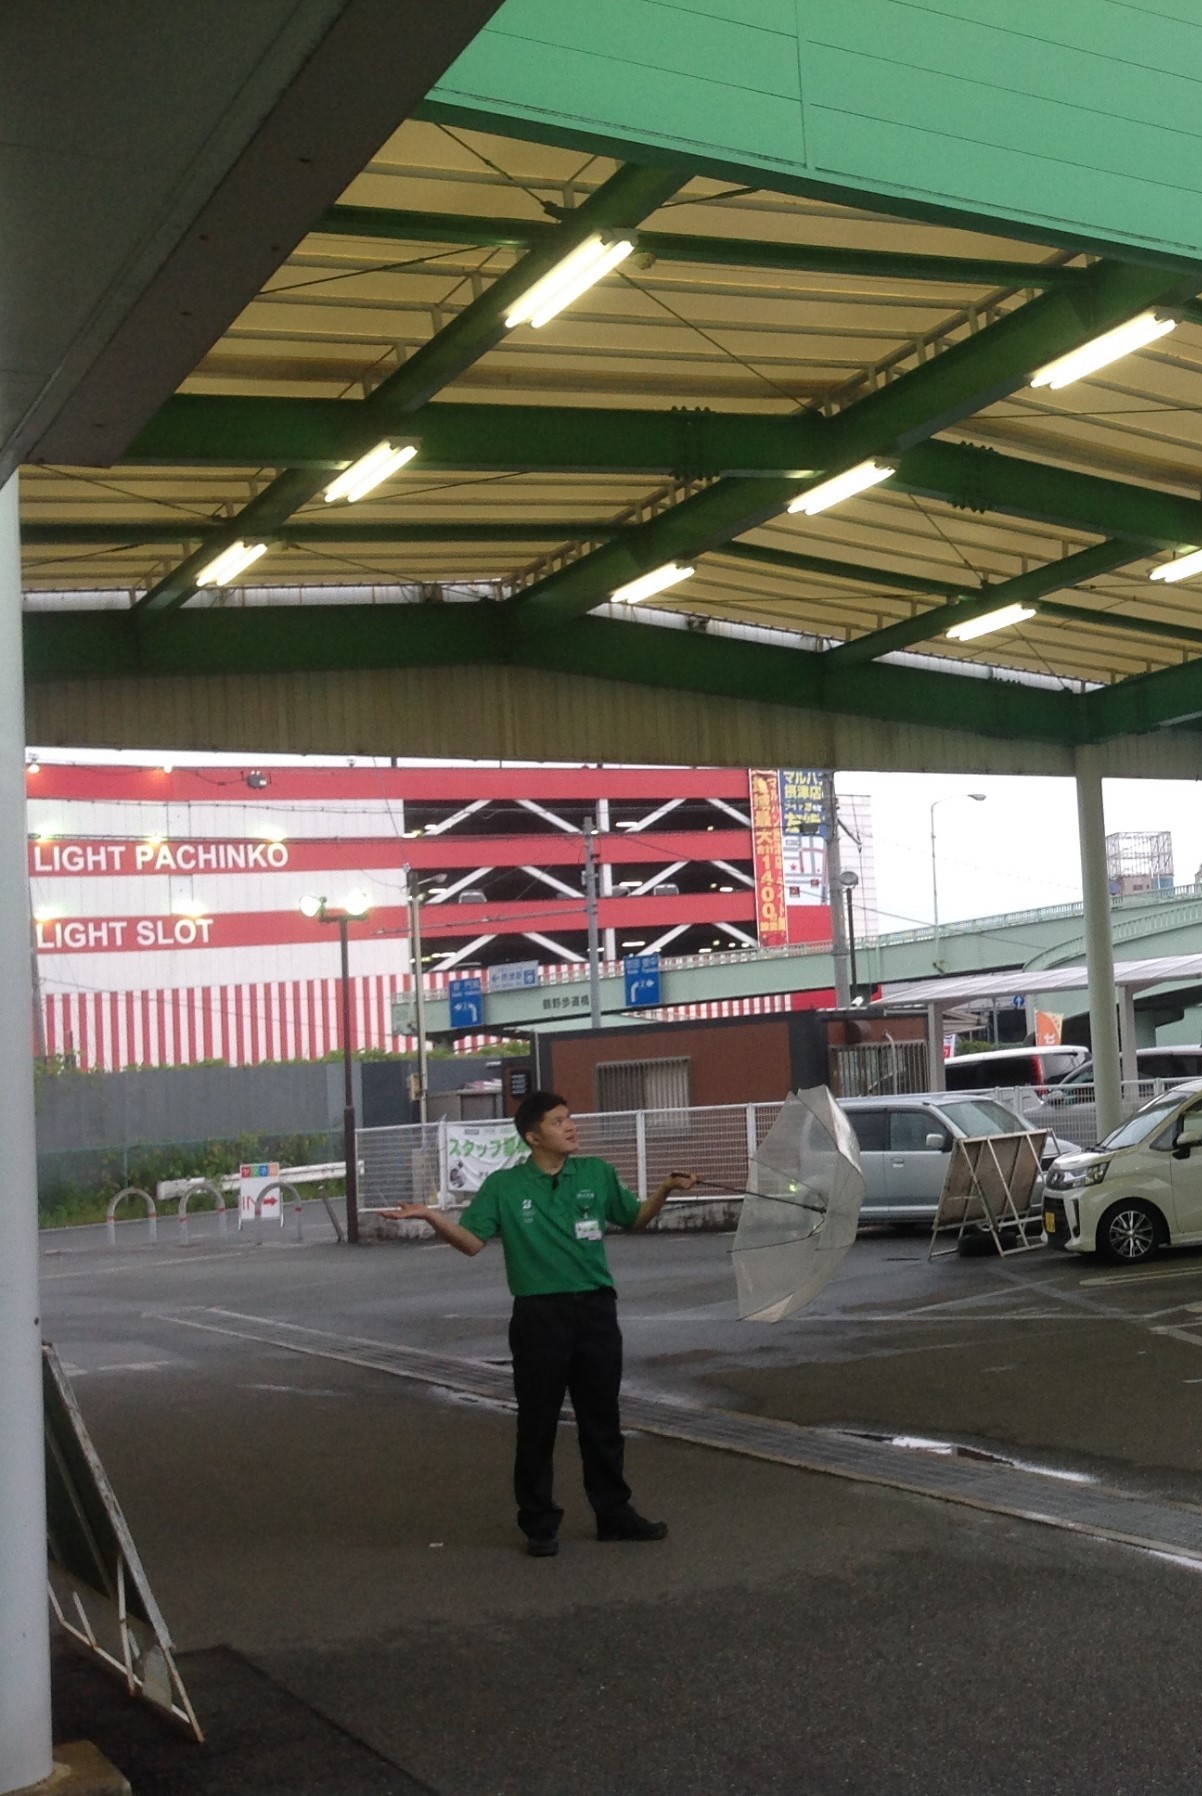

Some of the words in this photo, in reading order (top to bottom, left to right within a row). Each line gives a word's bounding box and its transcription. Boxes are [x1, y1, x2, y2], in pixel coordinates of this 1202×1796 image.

[33, 845, 126, 873] LIGHT
[135, 842, 289, 870] PACHINKO
[36, 920, 127, 949] LIGHT
[136, 918, 214, 946] SLOT
